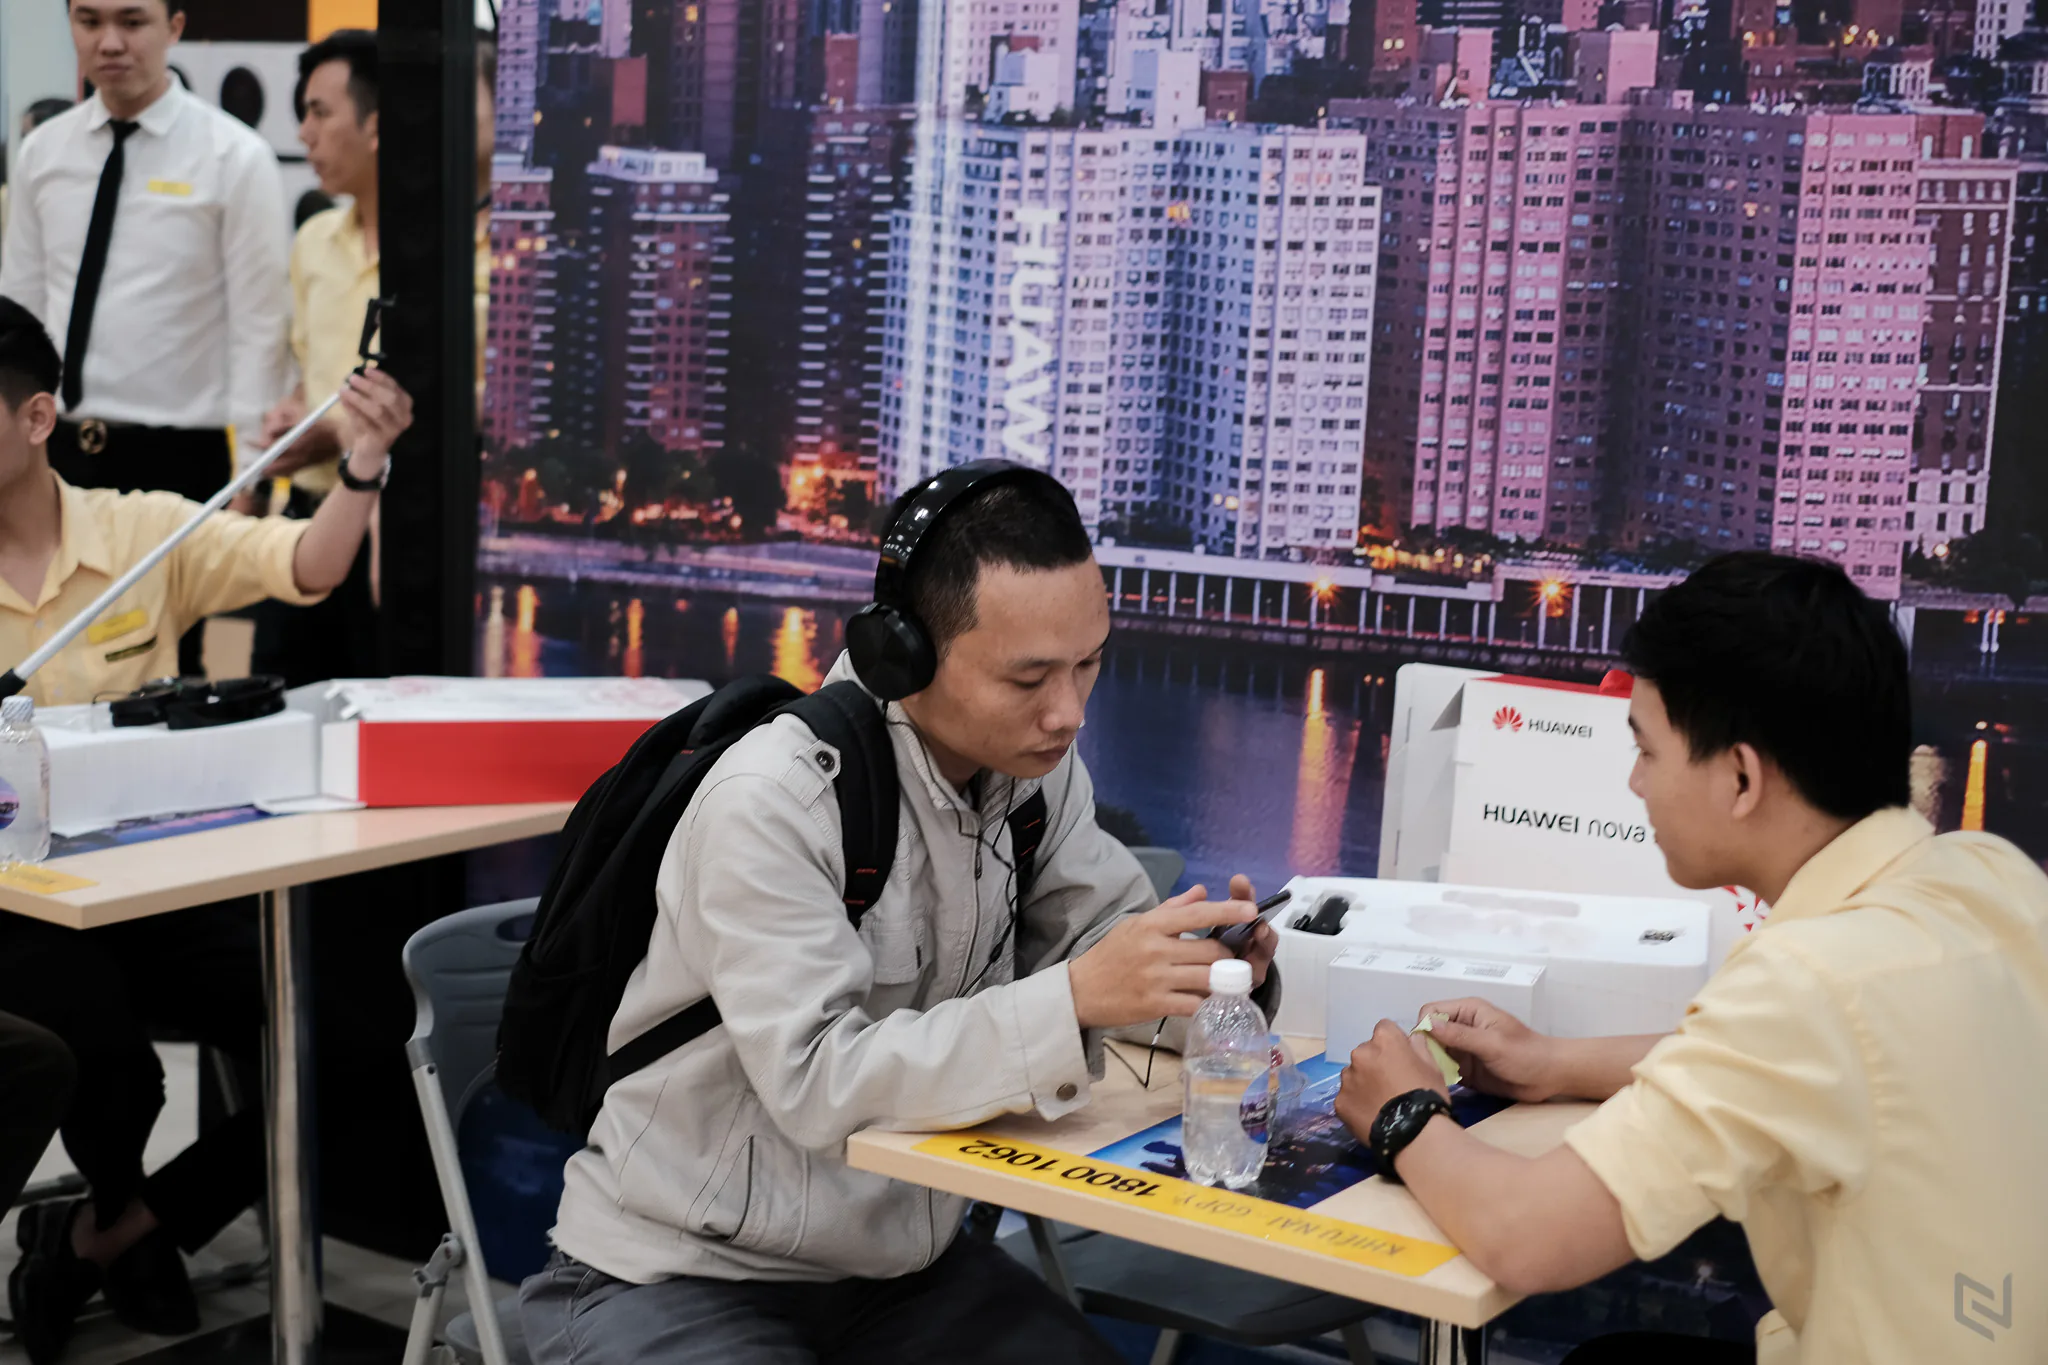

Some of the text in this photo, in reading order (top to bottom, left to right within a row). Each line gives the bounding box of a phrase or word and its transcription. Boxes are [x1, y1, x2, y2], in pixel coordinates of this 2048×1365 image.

[1528, 719, 1593, 739] HUAWEI
[1483, 803, 1646, 843] HUAWEI nova
[958, 1139, 1060, 1171] 1062
[1060, 1166, 1162, 1197] 1800
